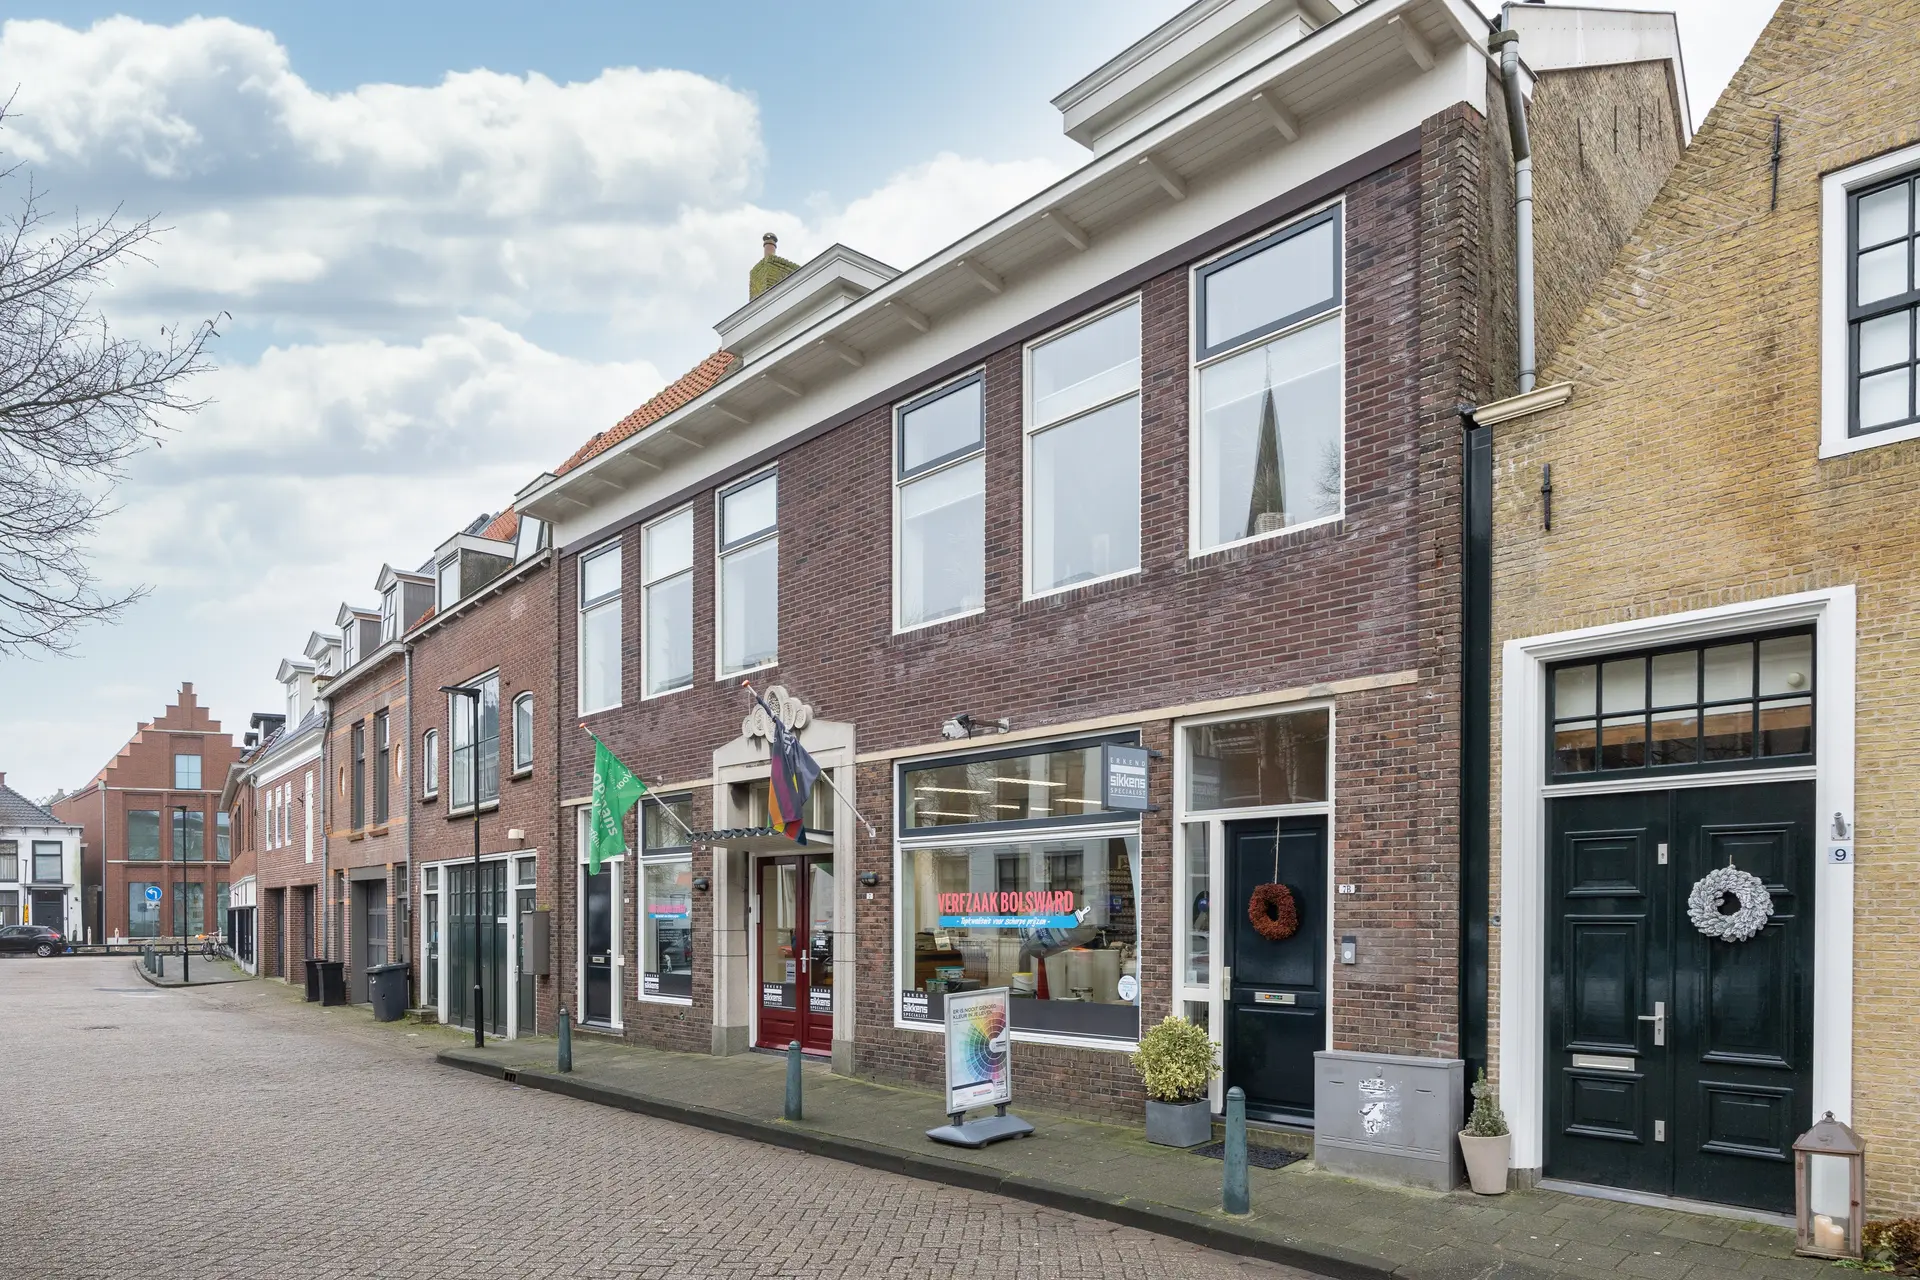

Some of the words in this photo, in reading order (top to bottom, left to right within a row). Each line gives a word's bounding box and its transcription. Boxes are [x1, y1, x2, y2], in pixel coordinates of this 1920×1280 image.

[1110, 757, 1146, 766] ERKEND
[1110, 774, 1146, 789] sikkens
[1834, 848, 1847, 861] 9
[1342, 885, 1352, 893] 7B
[938, 892, 999, 913] VERFZAAK
[1000, 890, 1074, 913] BOLSWARD
[1004, 917, 1026, 927] scherpe
[1026, 917, 1047, 928] prijzen
[903, 1003, 928, 1014] sikkens
